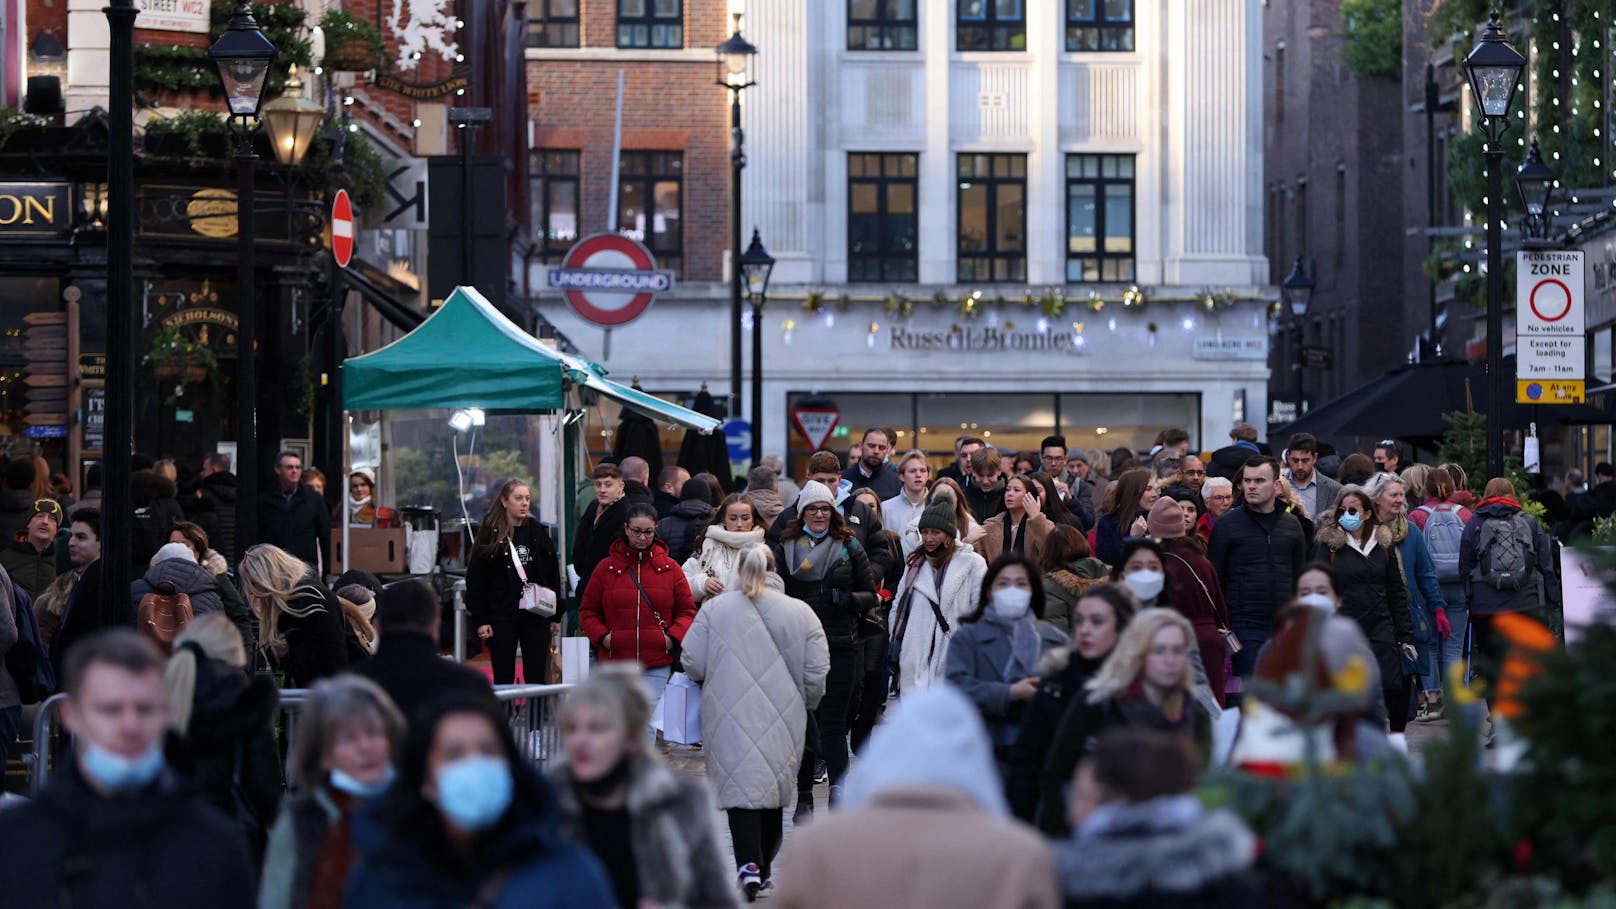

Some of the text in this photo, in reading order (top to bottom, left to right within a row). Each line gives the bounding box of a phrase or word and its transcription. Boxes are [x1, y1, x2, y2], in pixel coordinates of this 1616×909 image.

[140, 0, 203, 15] STREET WC2
[1523, 253, 1579, 261] PEDESTRIAN
[1530, 264, 1571, 275] ZONE
[550, 271, 669, 290] UNDERGROUND
[1541, 324, 1575, 333] vehicles
[1530, 340, 1572, 349] Except for
[1536, 349, 1566, 358] loading
[1529, 364, 1546, 372] 7am
[1554, 364, 1574, 372] 11am
[1550, 383, 1560, 391] At
